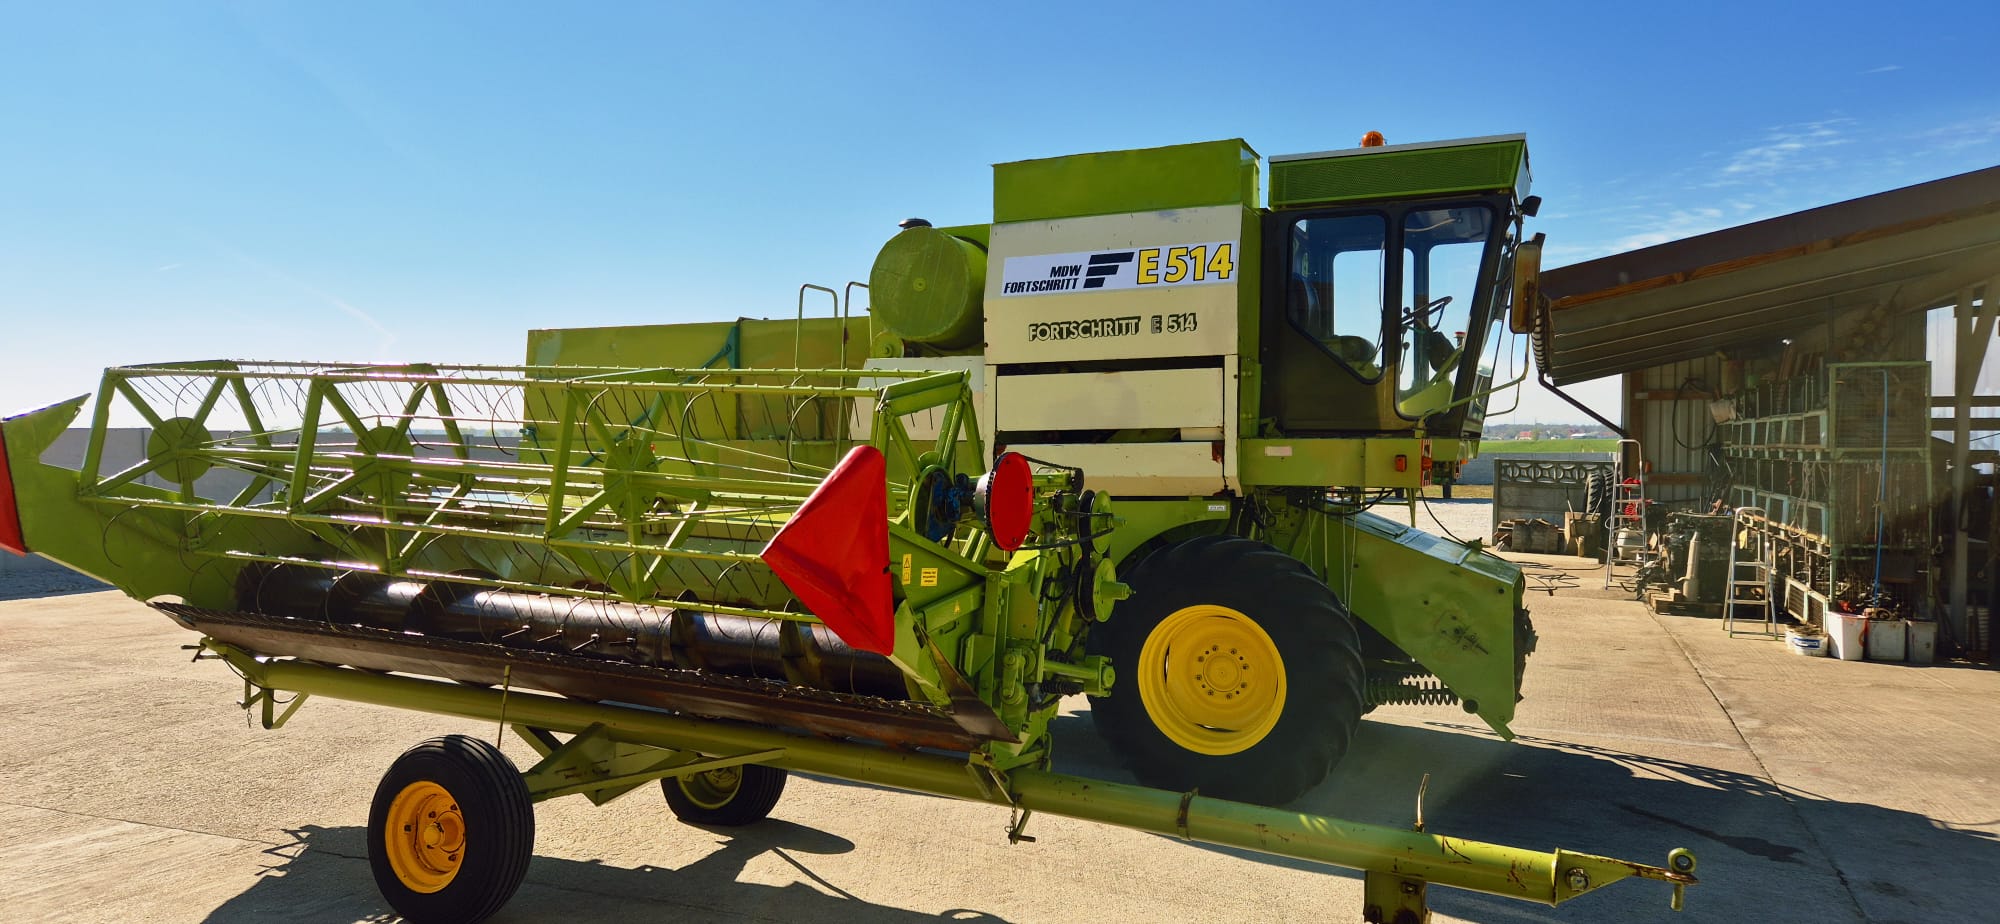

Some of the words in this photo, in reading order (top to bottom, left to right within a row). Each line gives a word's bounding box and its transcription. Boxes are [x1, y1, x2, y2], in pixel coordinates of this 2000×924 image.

[1050, 264, 1082, 278] MDW
[1137, 248, 1160, 285] E
[1164, 243, 1233, 283] 514
[1003, 278, 1079, 294] FORTSCHRITT
[1028, 315, 1141, 342] FORTSCHRITT
[1150, 316, 1163, 334] E
[1167, 312, 1197, 334] 514
